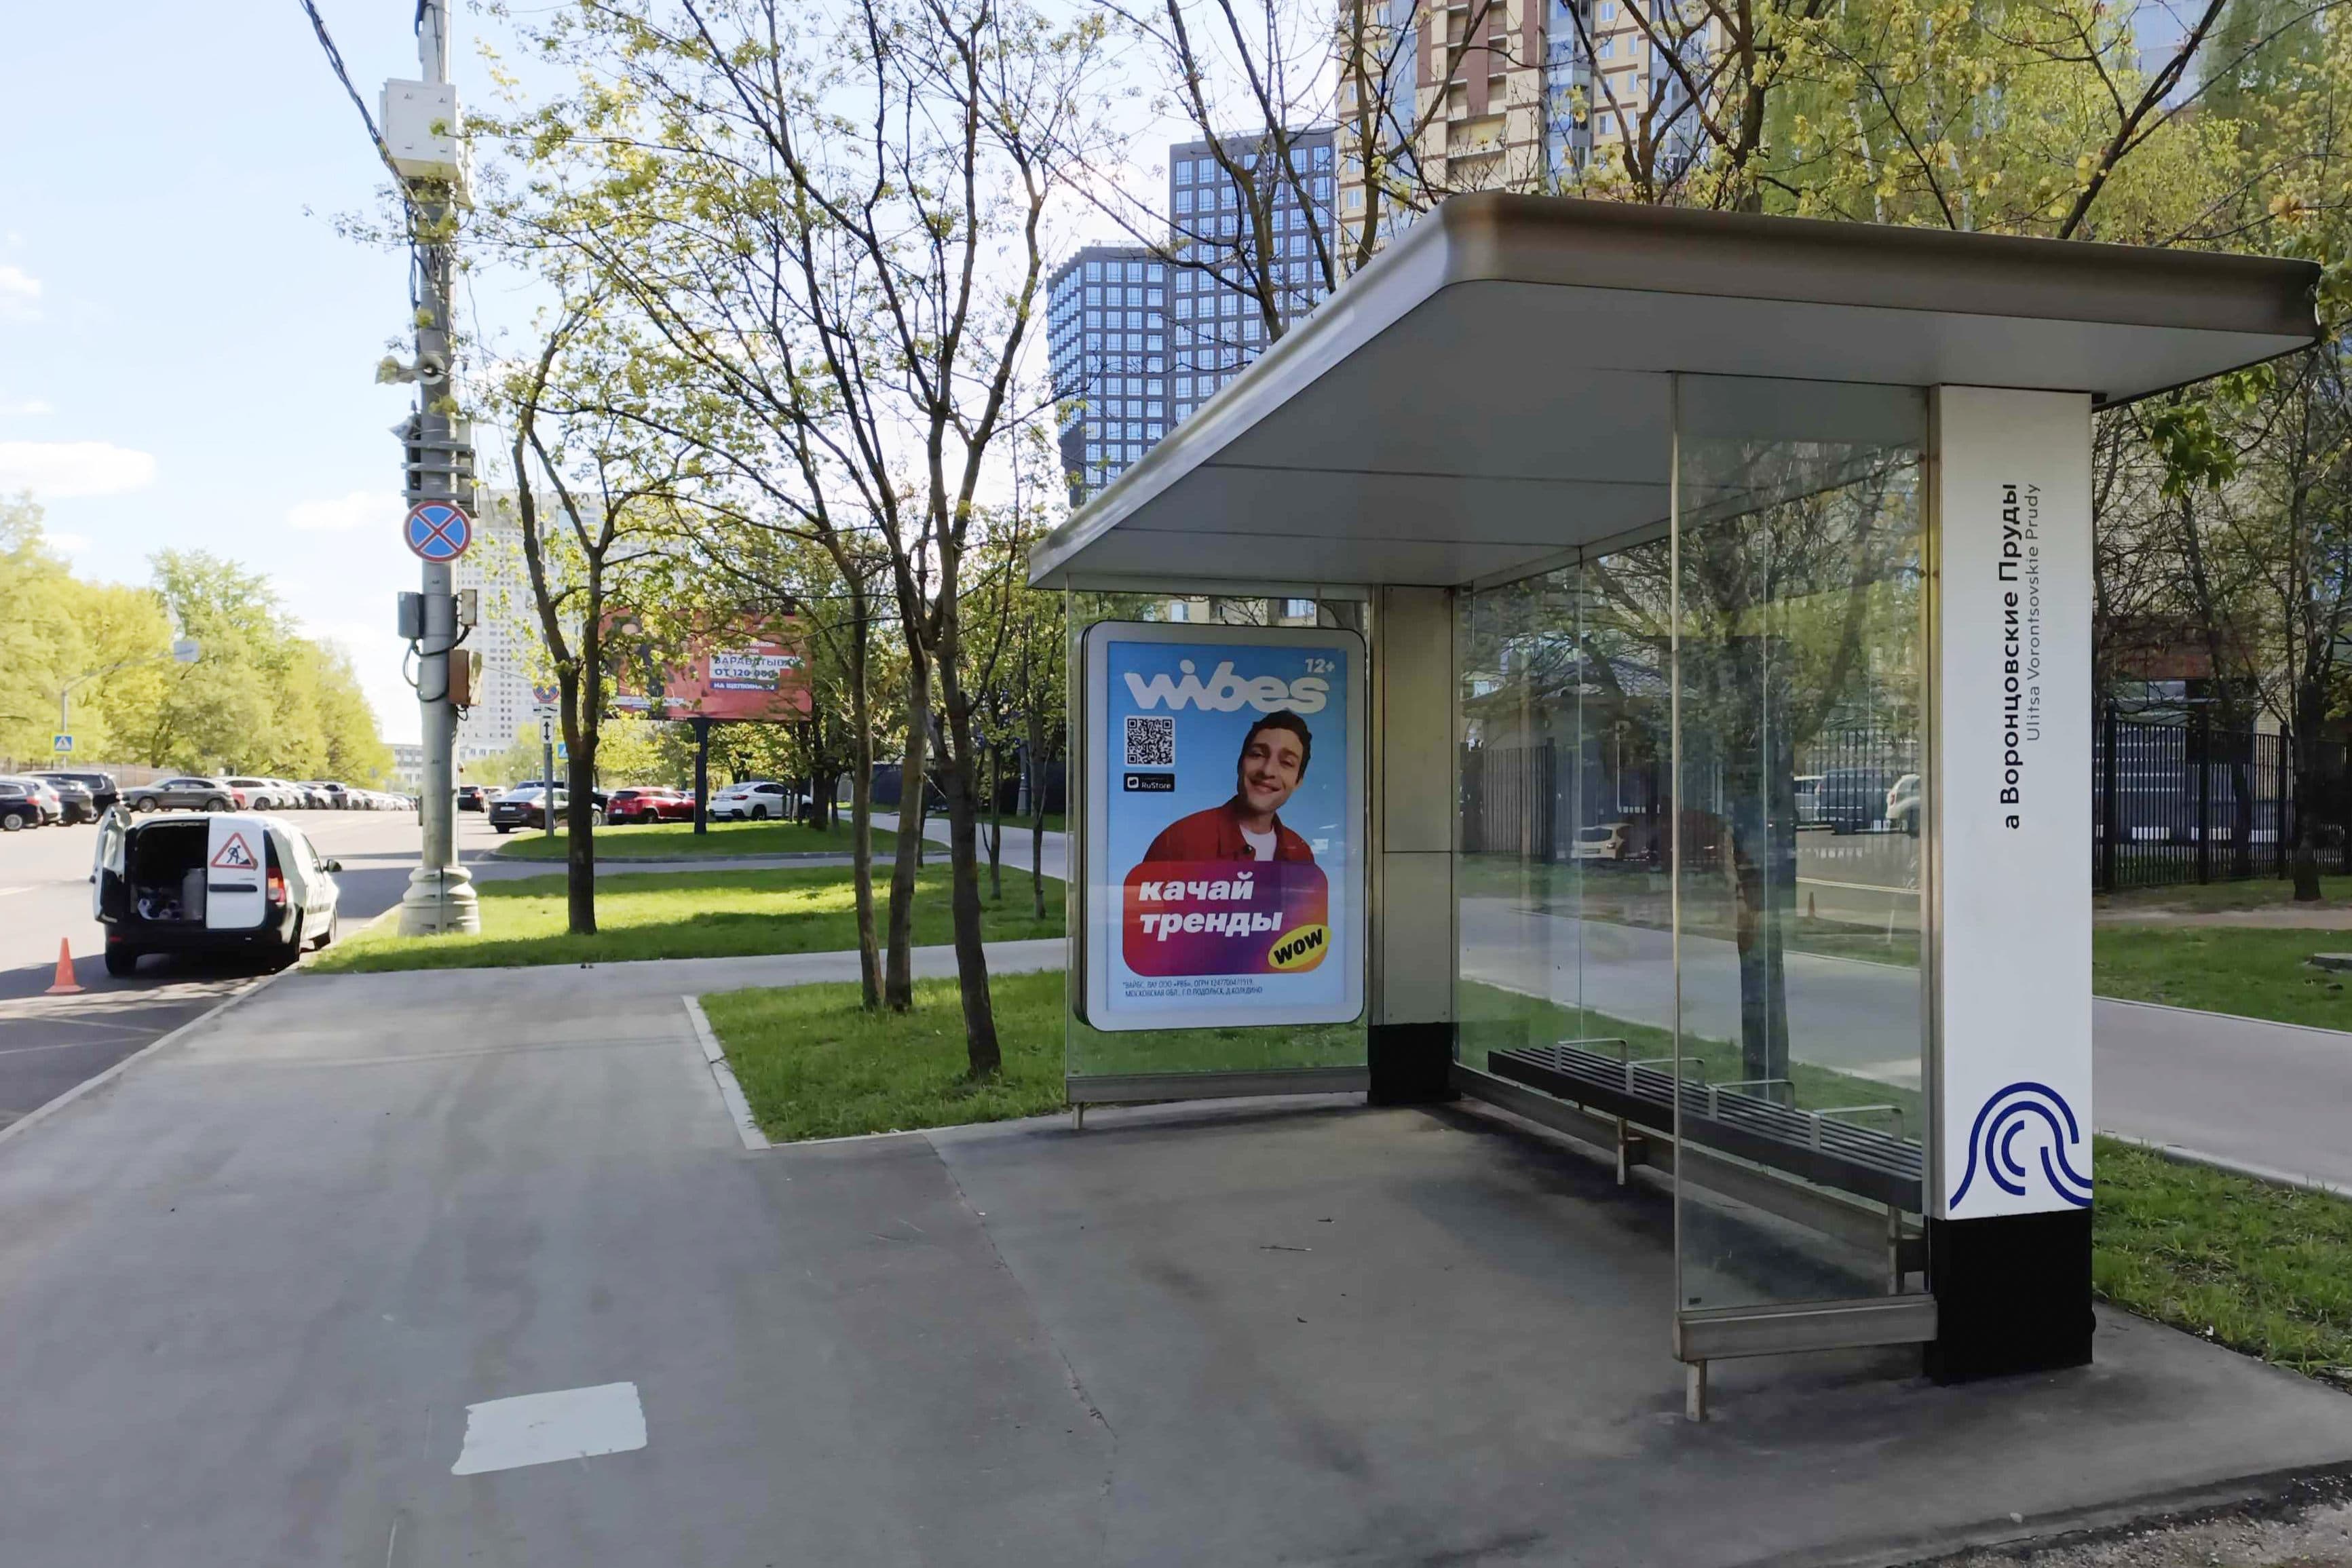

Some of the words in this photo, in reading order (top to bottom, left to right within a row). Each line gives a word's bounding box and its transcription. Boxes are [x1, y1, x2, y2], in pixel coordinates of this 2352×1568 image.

[1998, 484, 2023, 581] Пруды
[2025, 484, 2041, 540] Prudy
[2026, 546, 2041, 681] Vorontsovskie
[715, 668, 729, 676] ОТ
[1124, 659, 1329, 714] wibes
[1305, 658, 1335, 673] 12+
[2000, 592, 2023, 804] Воронцовские
[2026, 687, 2041, 741] Ulitsa
[1139, 871, 1254, 901] качай
[1140, 912, 1283, 941] тренды
